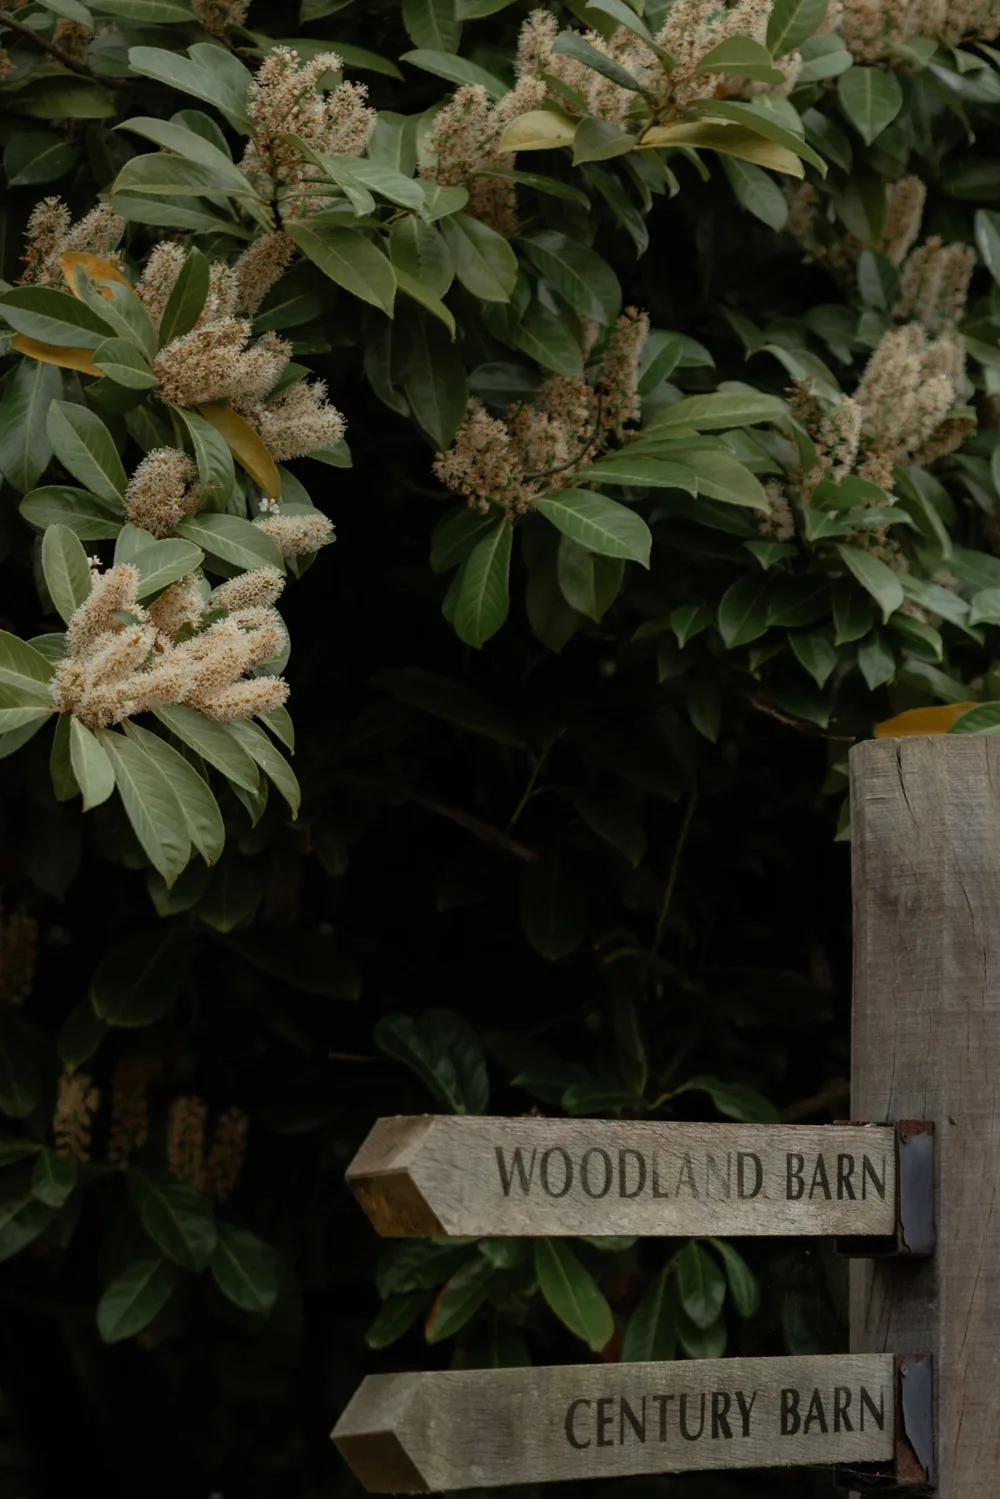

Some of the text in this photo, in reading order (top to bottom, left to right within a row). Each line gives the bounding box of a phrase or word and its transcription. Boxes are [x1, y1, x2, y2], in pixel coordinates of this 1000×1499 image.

[494, 1146, 887, 1201] WOODLAND BARN
[565, 1385, 885, 1449] CENTURY BARN
